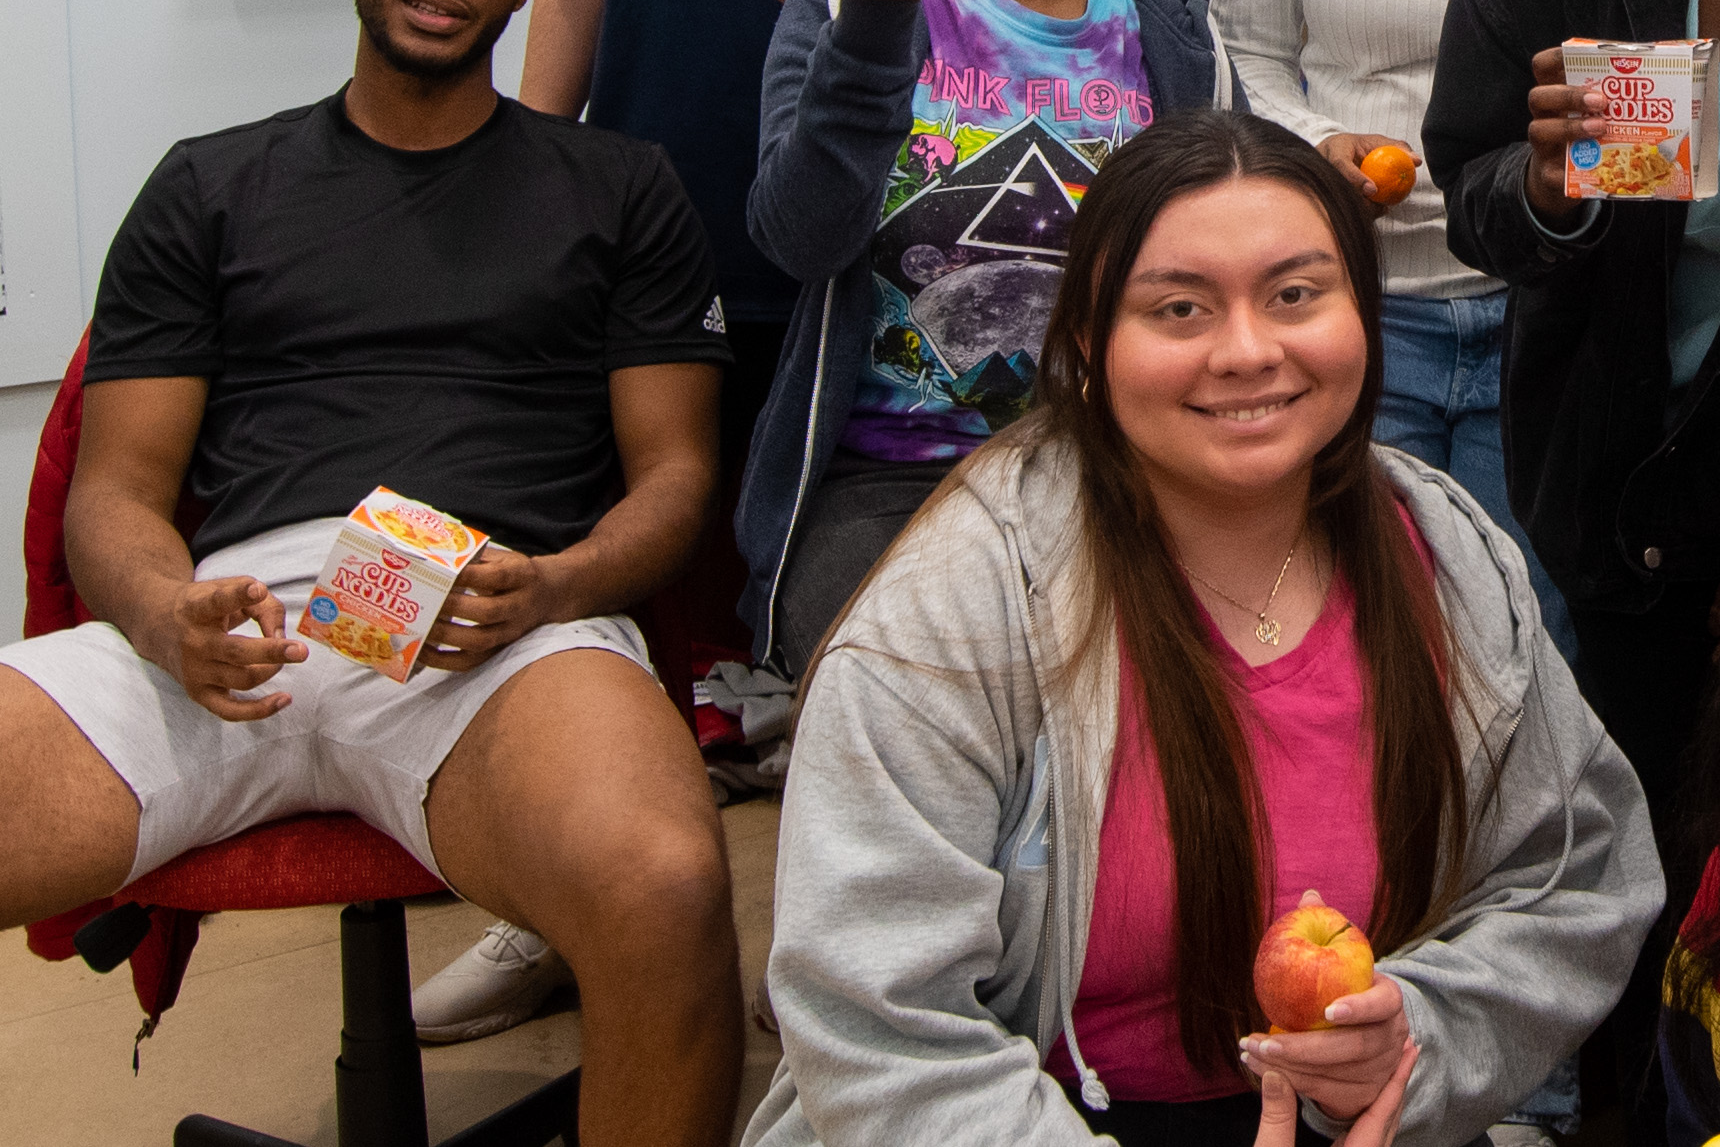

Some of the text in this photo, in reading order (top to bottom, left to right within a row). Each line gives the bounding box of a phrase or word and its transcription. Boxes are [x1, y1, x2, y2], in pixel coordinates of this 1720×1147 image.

[1602, 76, 1655, 100] CUP
[361, 562, 412, 593] CUP
[331, 567, 420, 623] NOODLES
